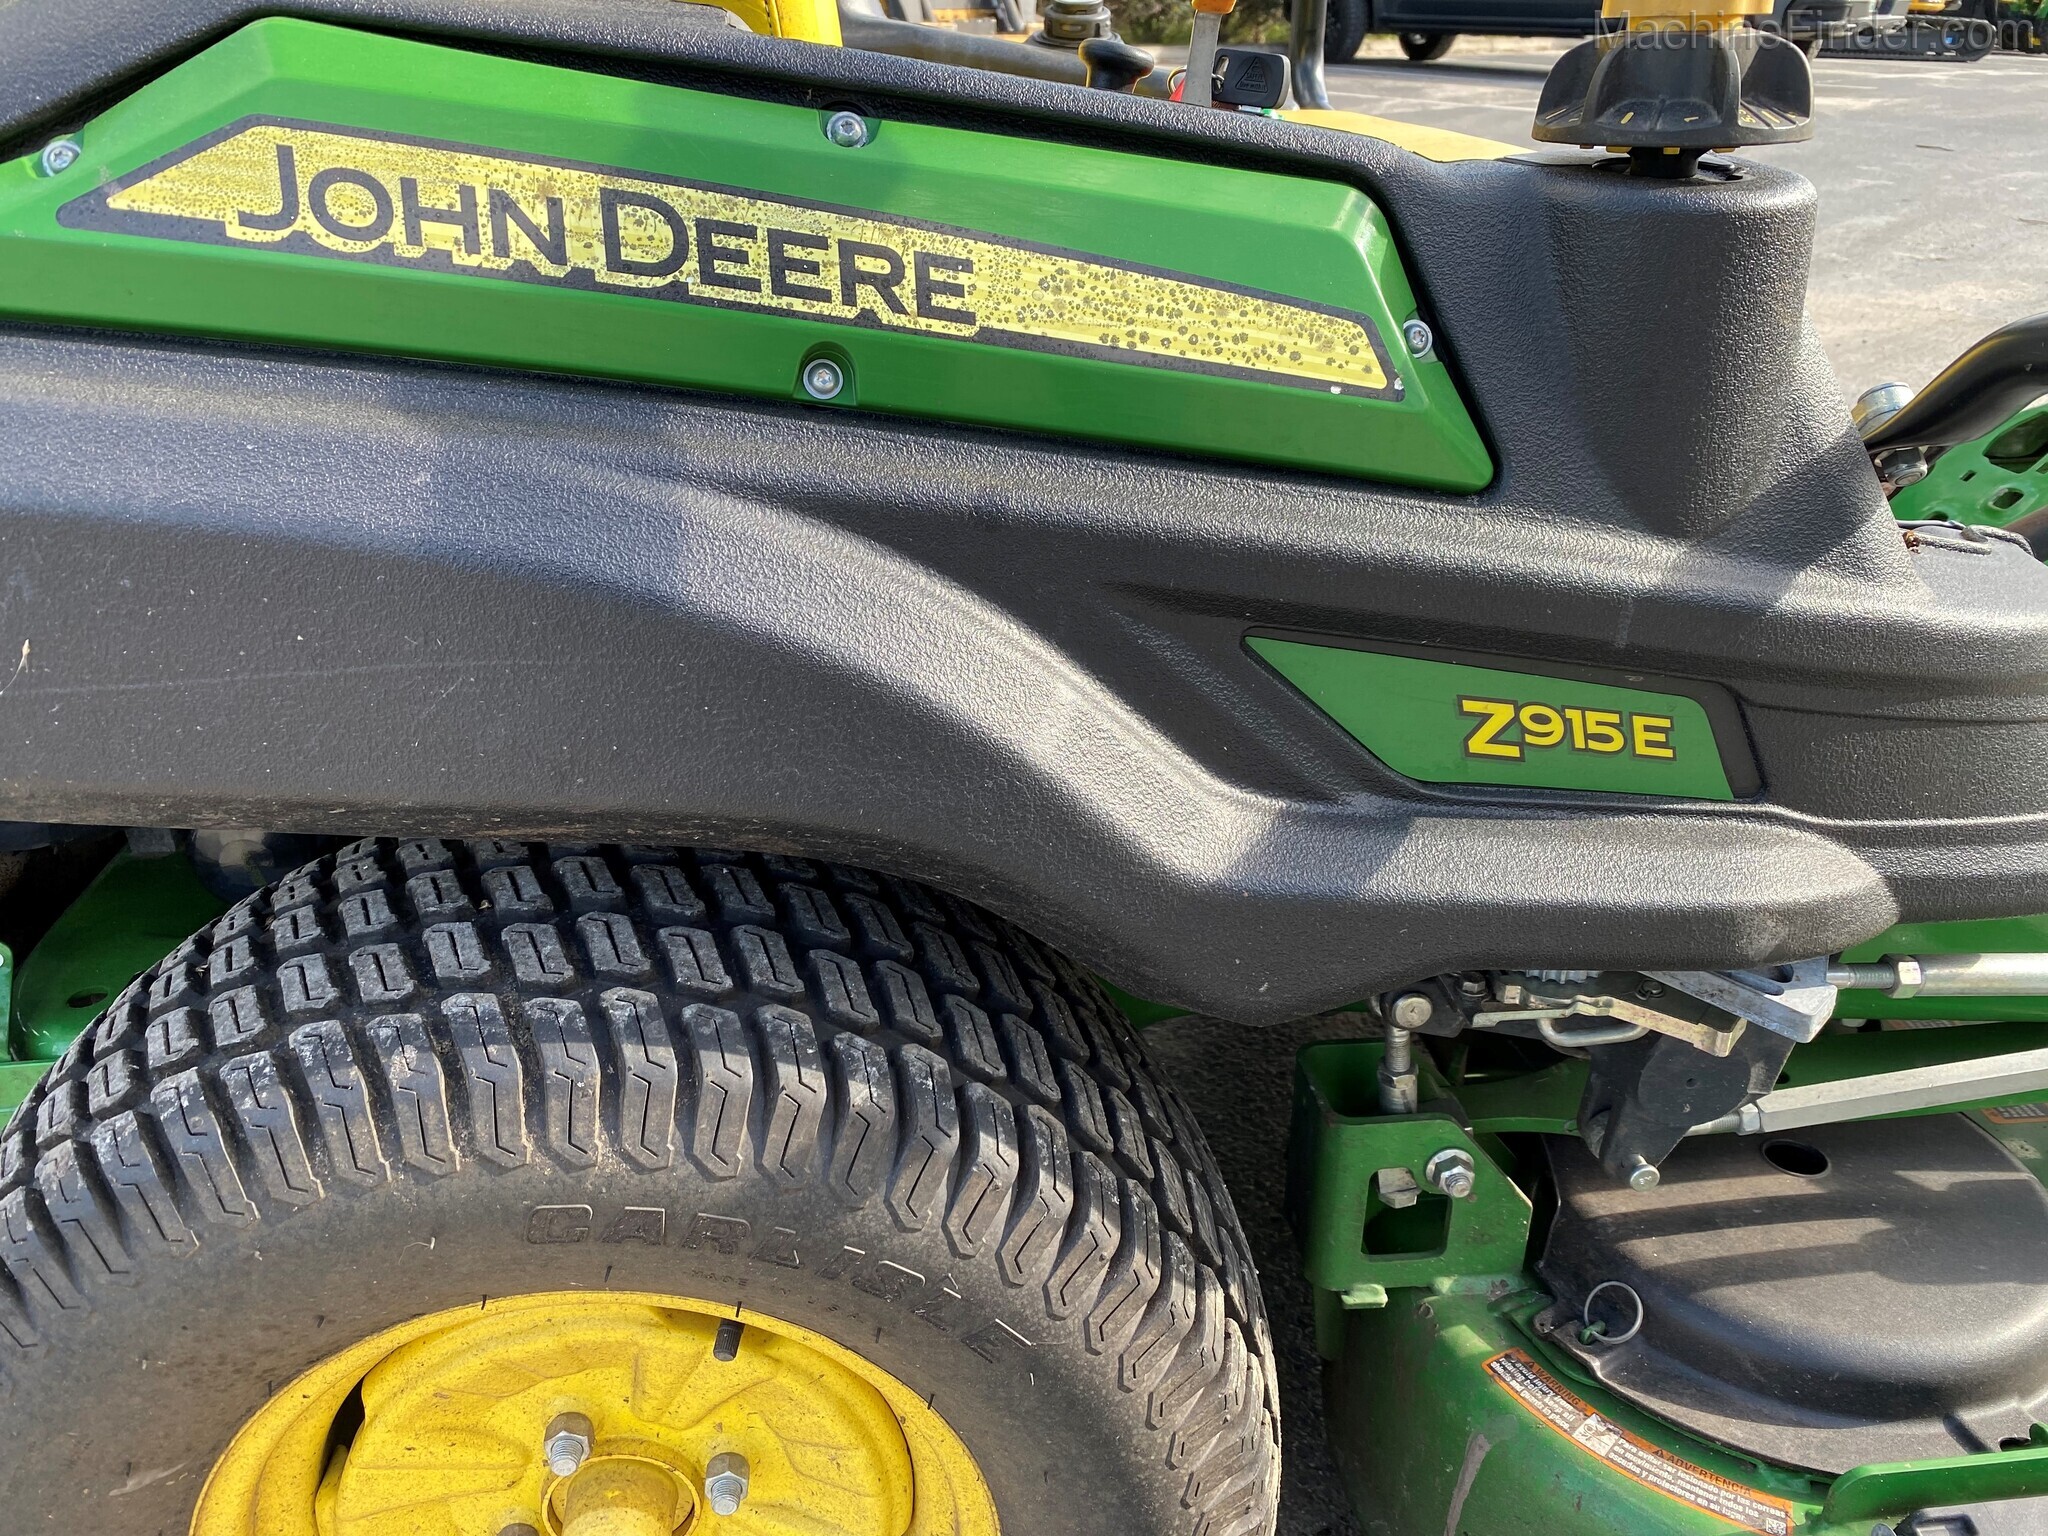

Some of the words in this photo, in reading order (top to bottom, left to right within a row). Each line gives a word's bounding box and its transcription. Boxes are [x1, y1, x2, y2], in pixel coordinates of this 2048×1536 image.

[238, 144, 572, 267] JOHN
[602, 186, 976, 326] DEERE
[526, 1204, 1036, 1362] CARLISLE
[1510, 1380, 1523, 1392] and
[1535, 1368, 1581, 1406] WARNING
[1618, 1438, 1637, 1453] Para
[1720, 1490, 1735, 1499] por
[1737, 1495, 1750, 1505] las
[1752, 1501, 1786, 1518] correas
[1667, 1455, 1752, 1496] ADVERTENCIA
[1746, 1507, 1759, 1517] los
